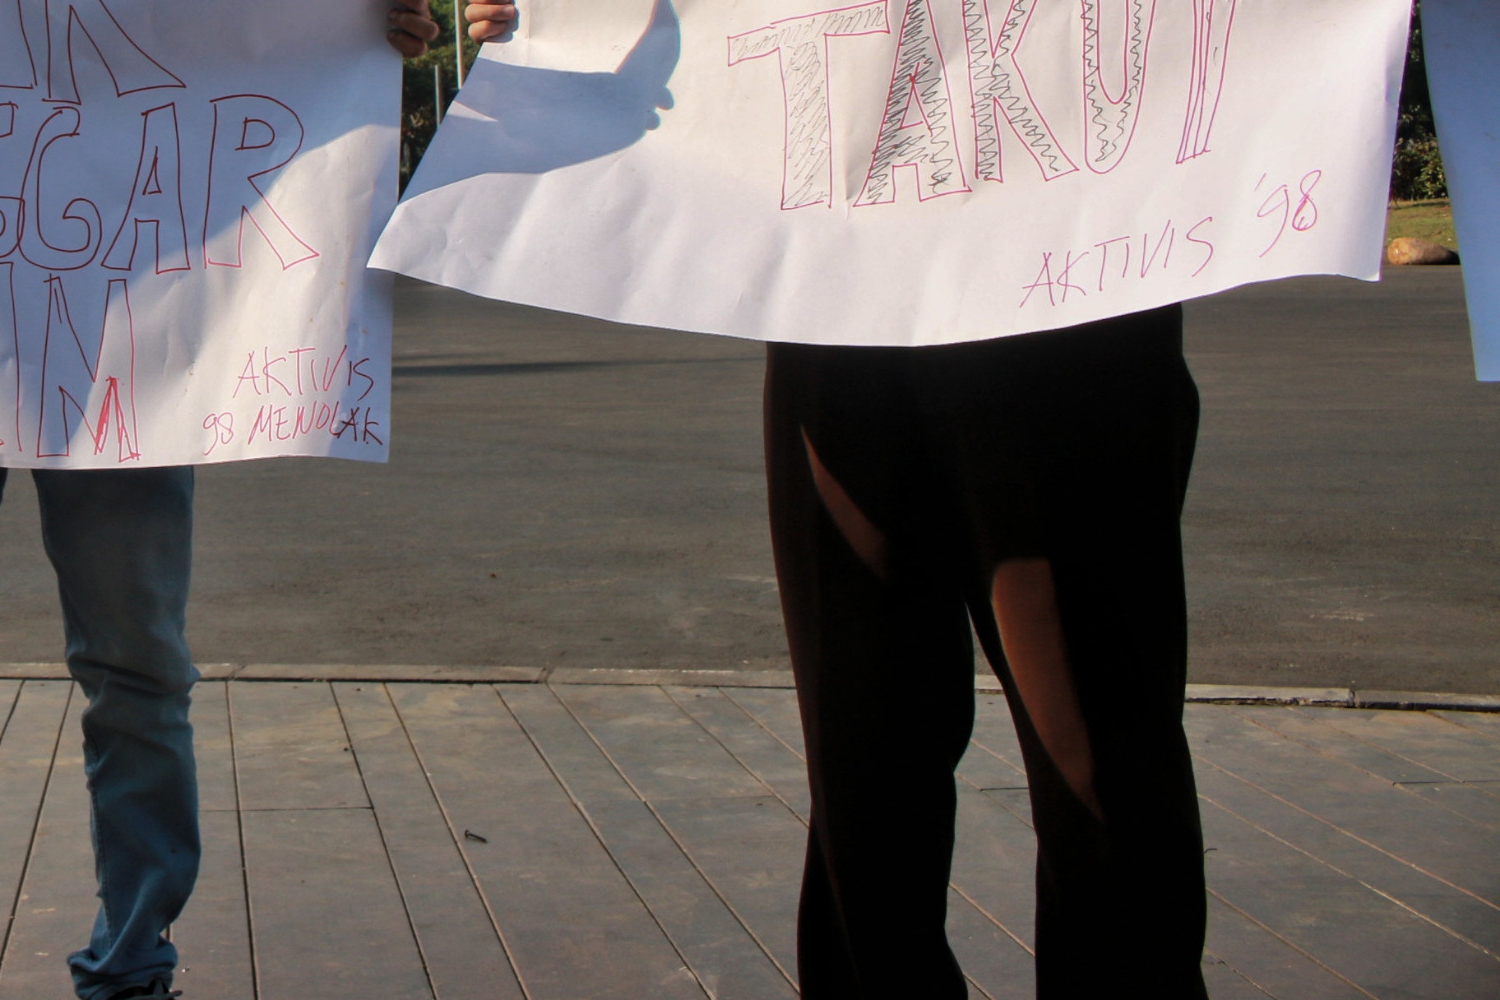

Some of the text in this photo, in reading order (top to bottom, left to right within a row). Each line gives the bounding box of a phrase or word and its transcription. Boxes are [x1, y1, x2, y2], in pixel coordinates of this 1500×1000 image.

[1020, 170, 1322, 309] AKTIVIS '98
[232, 345, 374, 401] AKTIVIS
[202, 400, 383, 456] 98 MENOLAK
